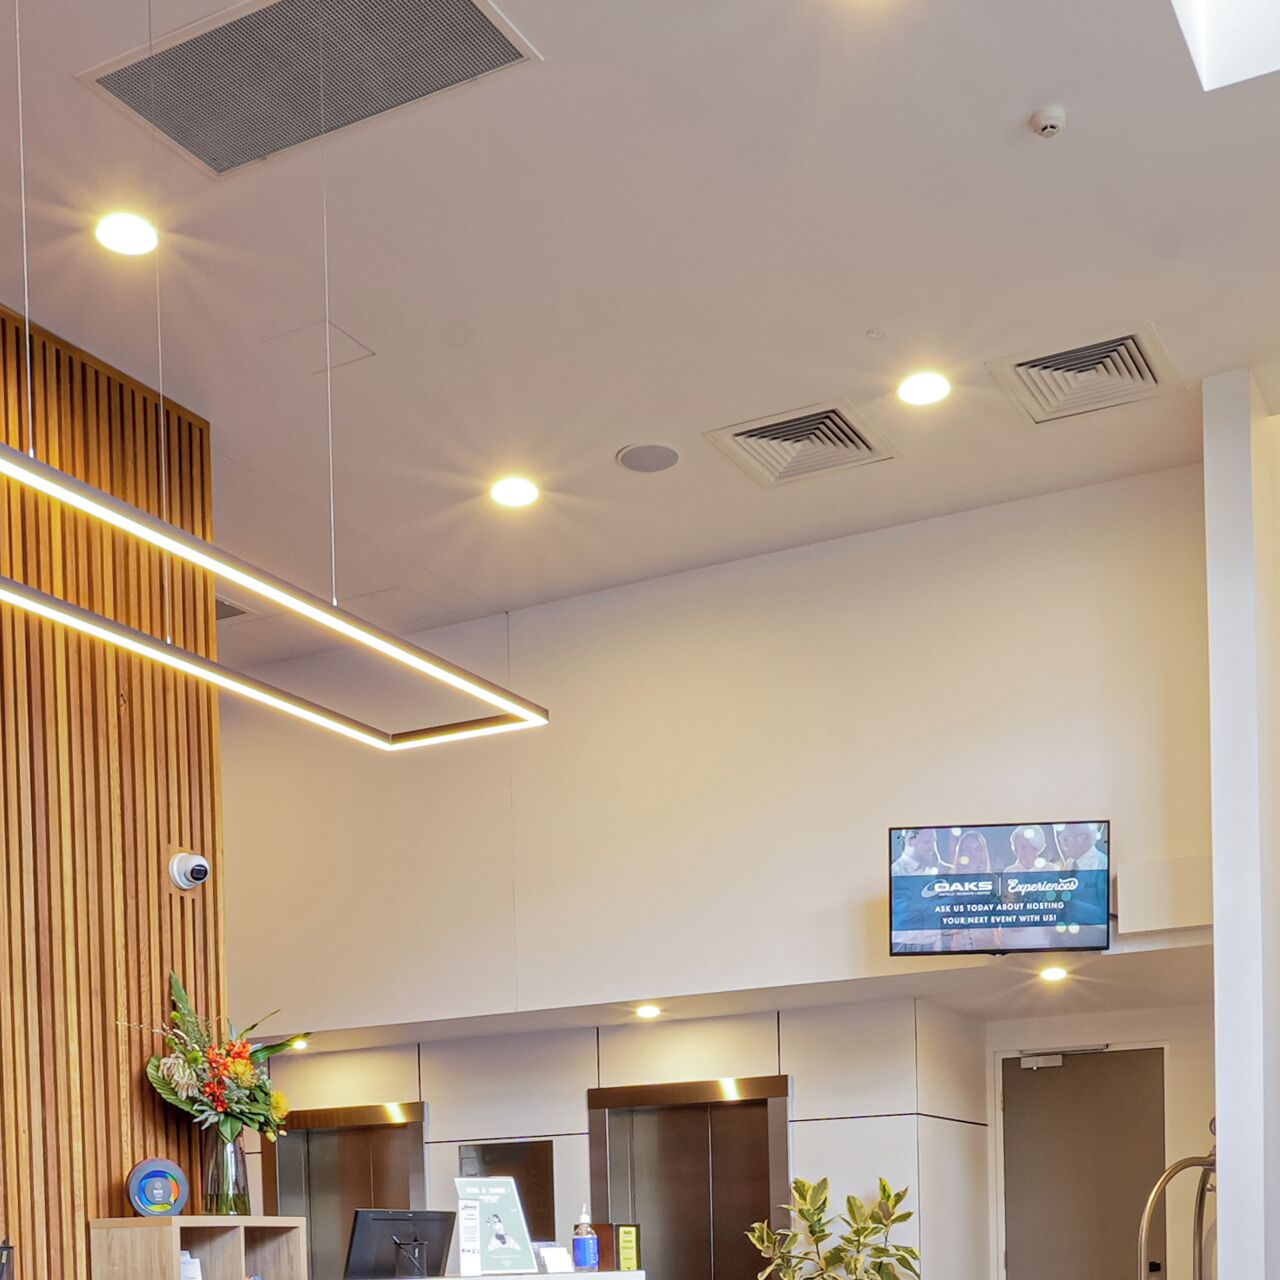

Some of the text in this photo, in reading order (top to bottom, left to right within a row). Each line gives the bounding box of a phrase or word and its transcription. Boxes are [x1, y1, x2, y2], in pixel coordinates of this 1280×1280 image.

[934, 881, 992, 892] OAKS
[1007, 877, 1079, 895] Experiences
[935, 901, 1064, 912] ASK US TODAY ABOUT HOSTING
[942, 914, 1057, 924] YOUR NEXT EVENT WITH US!
